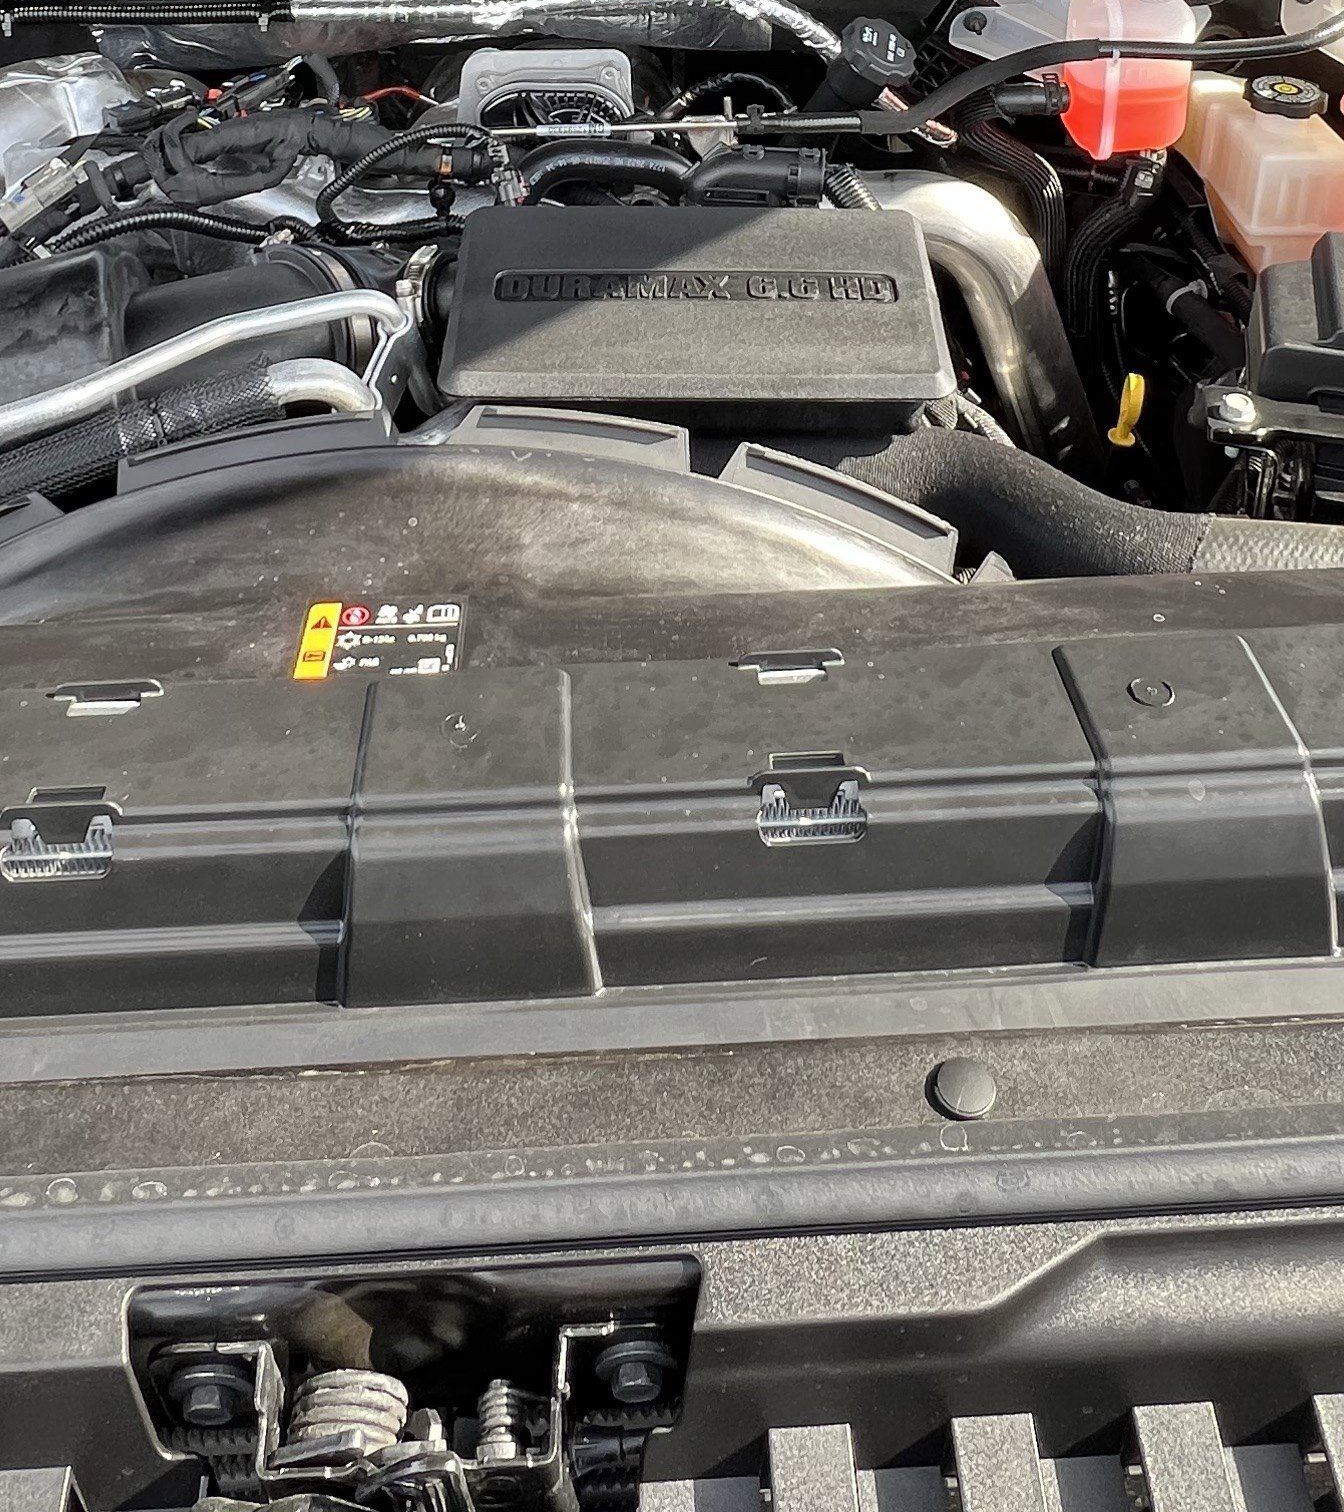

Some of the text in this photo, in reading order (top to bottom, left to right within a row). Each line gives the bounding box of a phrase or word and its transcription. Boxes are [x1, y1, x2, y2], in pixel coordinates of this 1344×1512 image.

[501, 273, 893, 303] DURAMAX 6.6 HD
